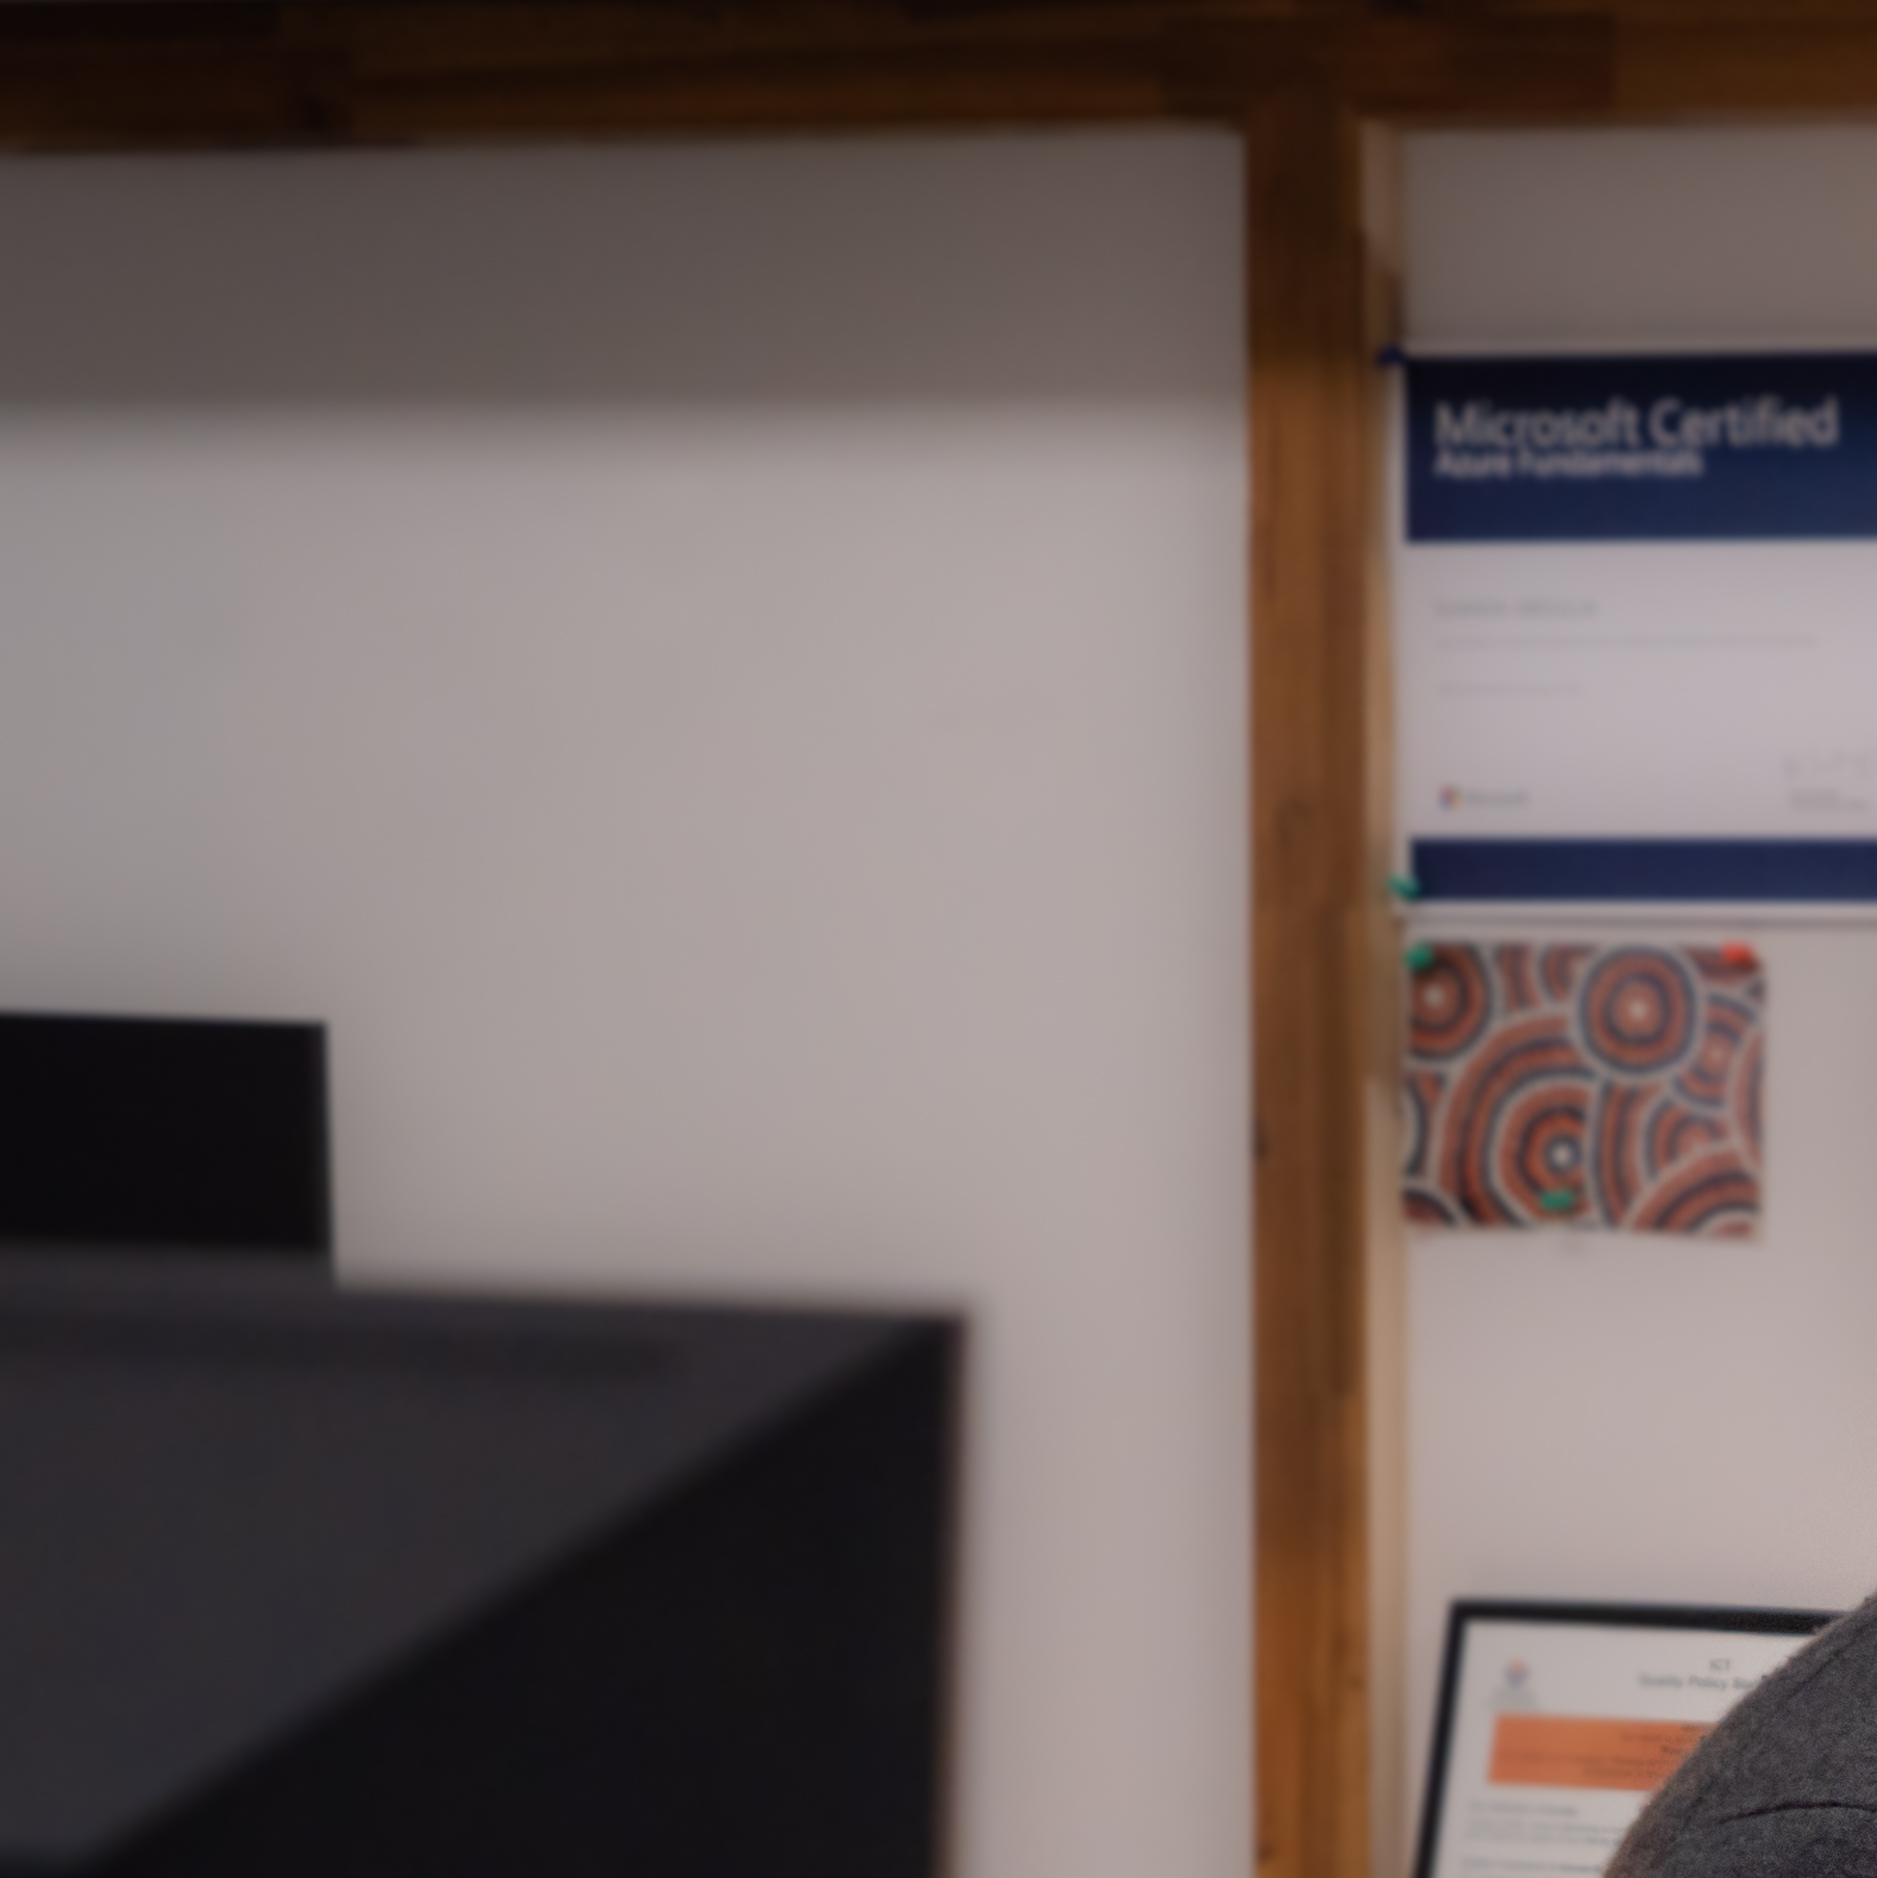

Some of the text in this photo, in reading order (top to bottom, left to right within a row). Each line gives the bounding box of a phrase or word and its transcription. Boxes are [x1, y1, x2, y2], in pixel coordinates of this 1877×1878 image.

[1434, 395, 1839, 448] Microsoft Certified
[1434, 448, 1705, 479] Azure Fundamentals
